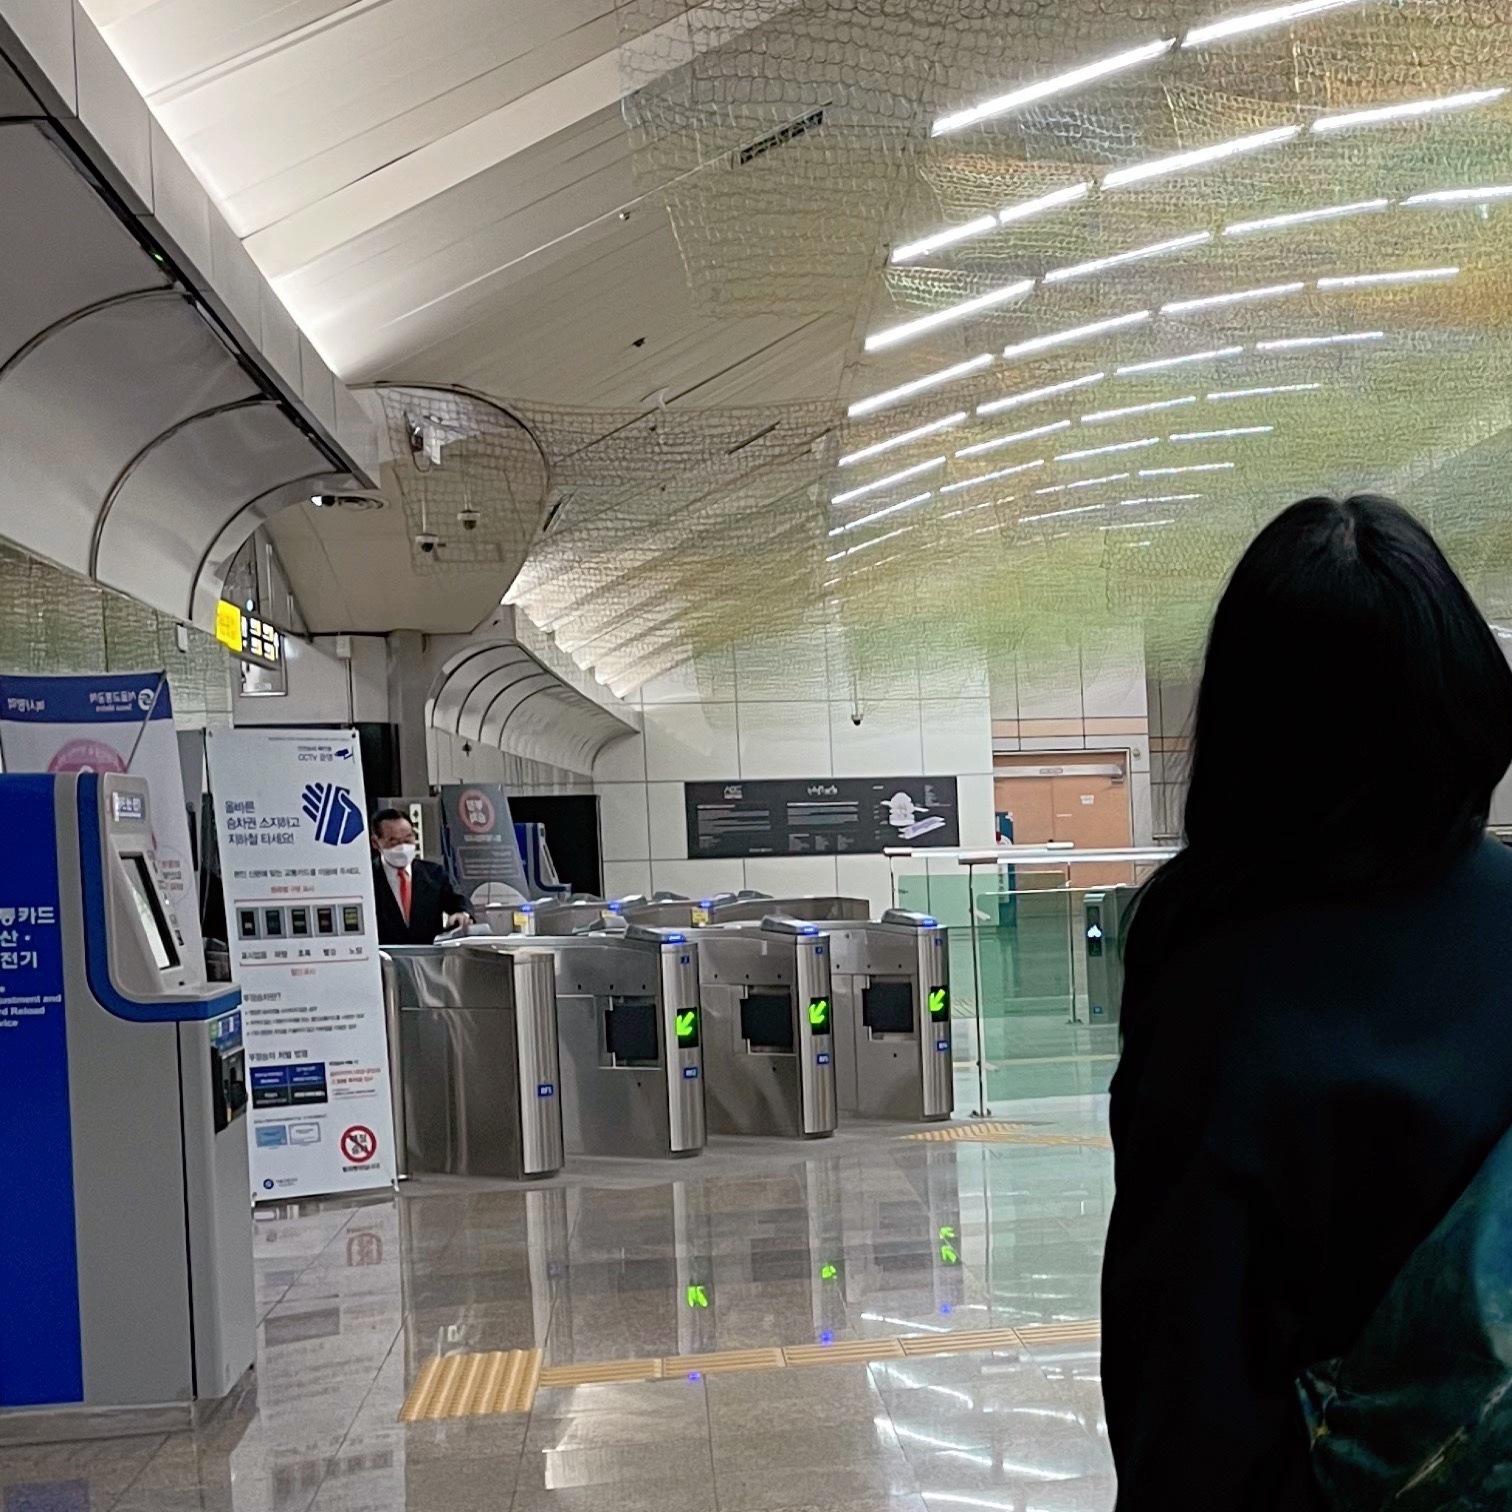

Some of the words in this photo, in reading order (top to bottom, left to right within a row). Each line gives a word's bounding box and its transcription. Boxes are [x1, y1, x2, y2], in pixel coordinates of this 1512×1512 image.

[225, 800, 255, 814] 올바른
[227, 817, 257, 830] 승차권
[259, 816, 300, 829] 소지하고
[228, 833, 258, 846] 지하철
[260, 832, 294, 846] 타세요!
